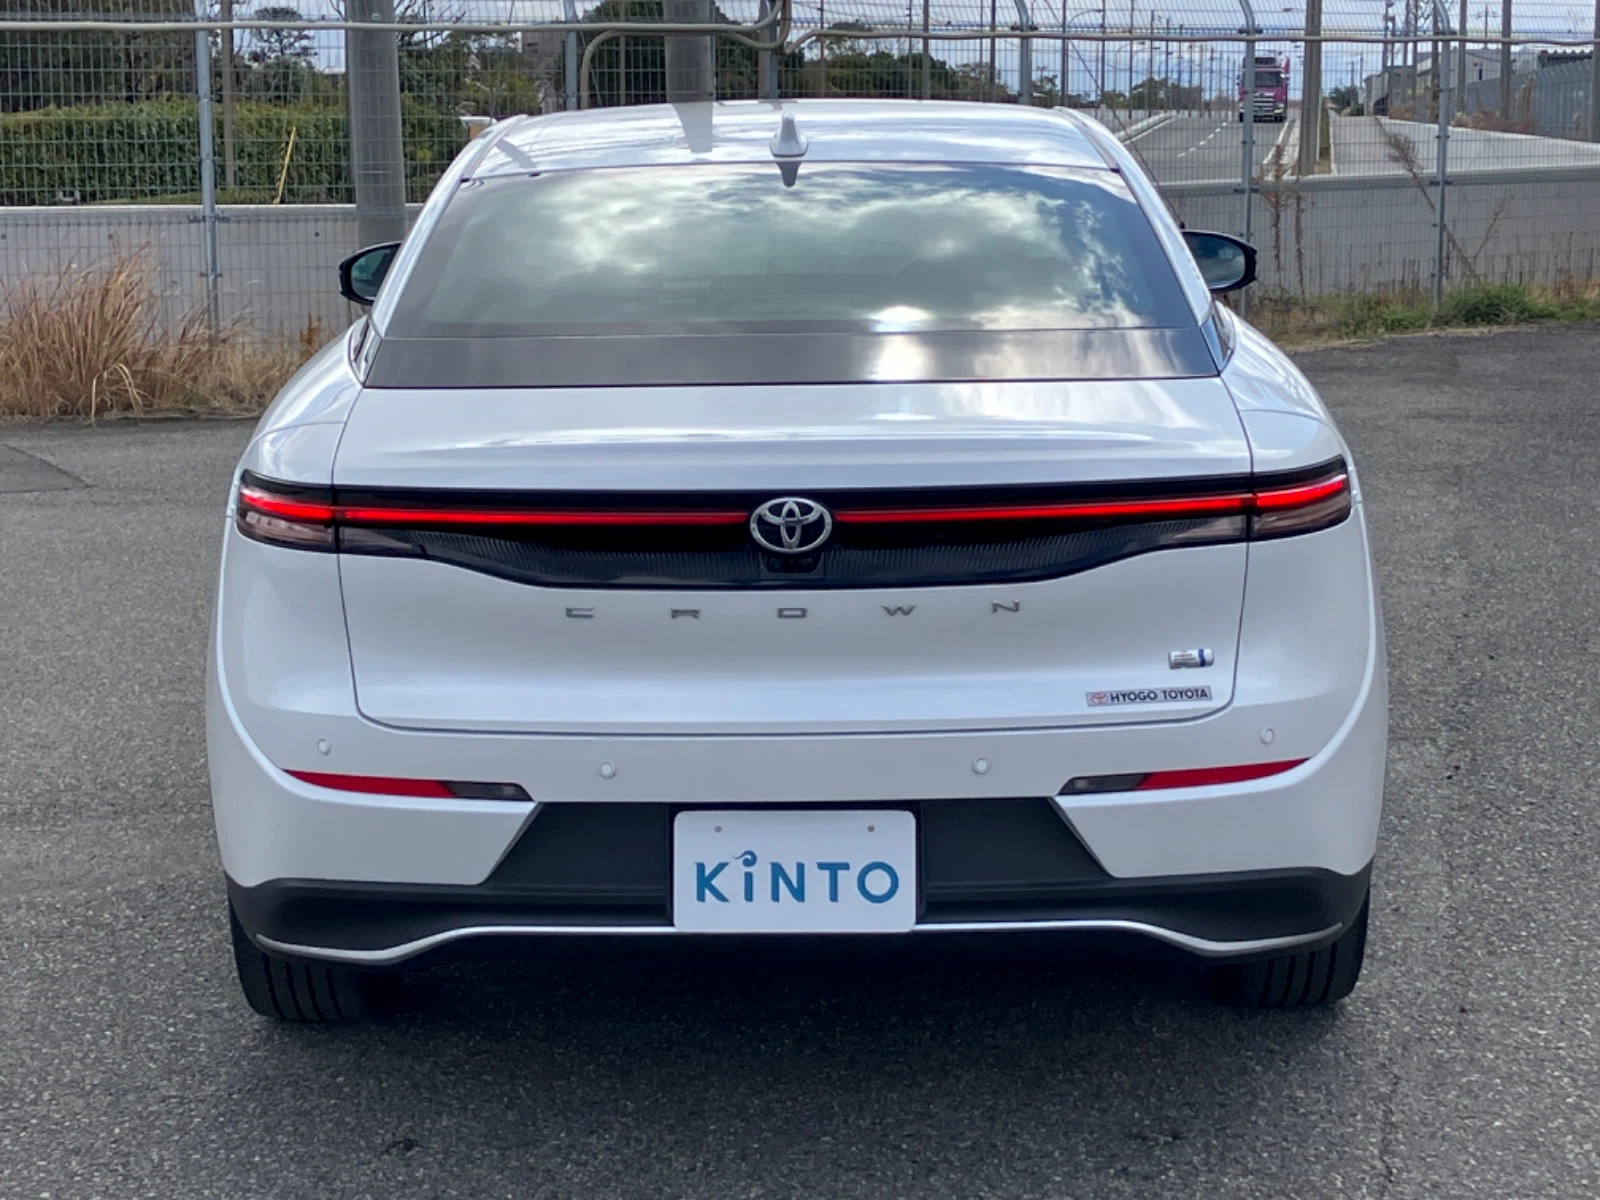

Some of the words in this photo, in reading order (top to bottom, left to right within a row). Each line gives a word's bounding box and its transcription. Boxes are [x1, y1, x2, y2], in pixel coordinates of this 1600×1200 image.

[565, 600, 1021, 619] CROWN
[1110, 691, 1158, 703] HYOGO
[1162, 688, 1208, 701] TOYOTA
